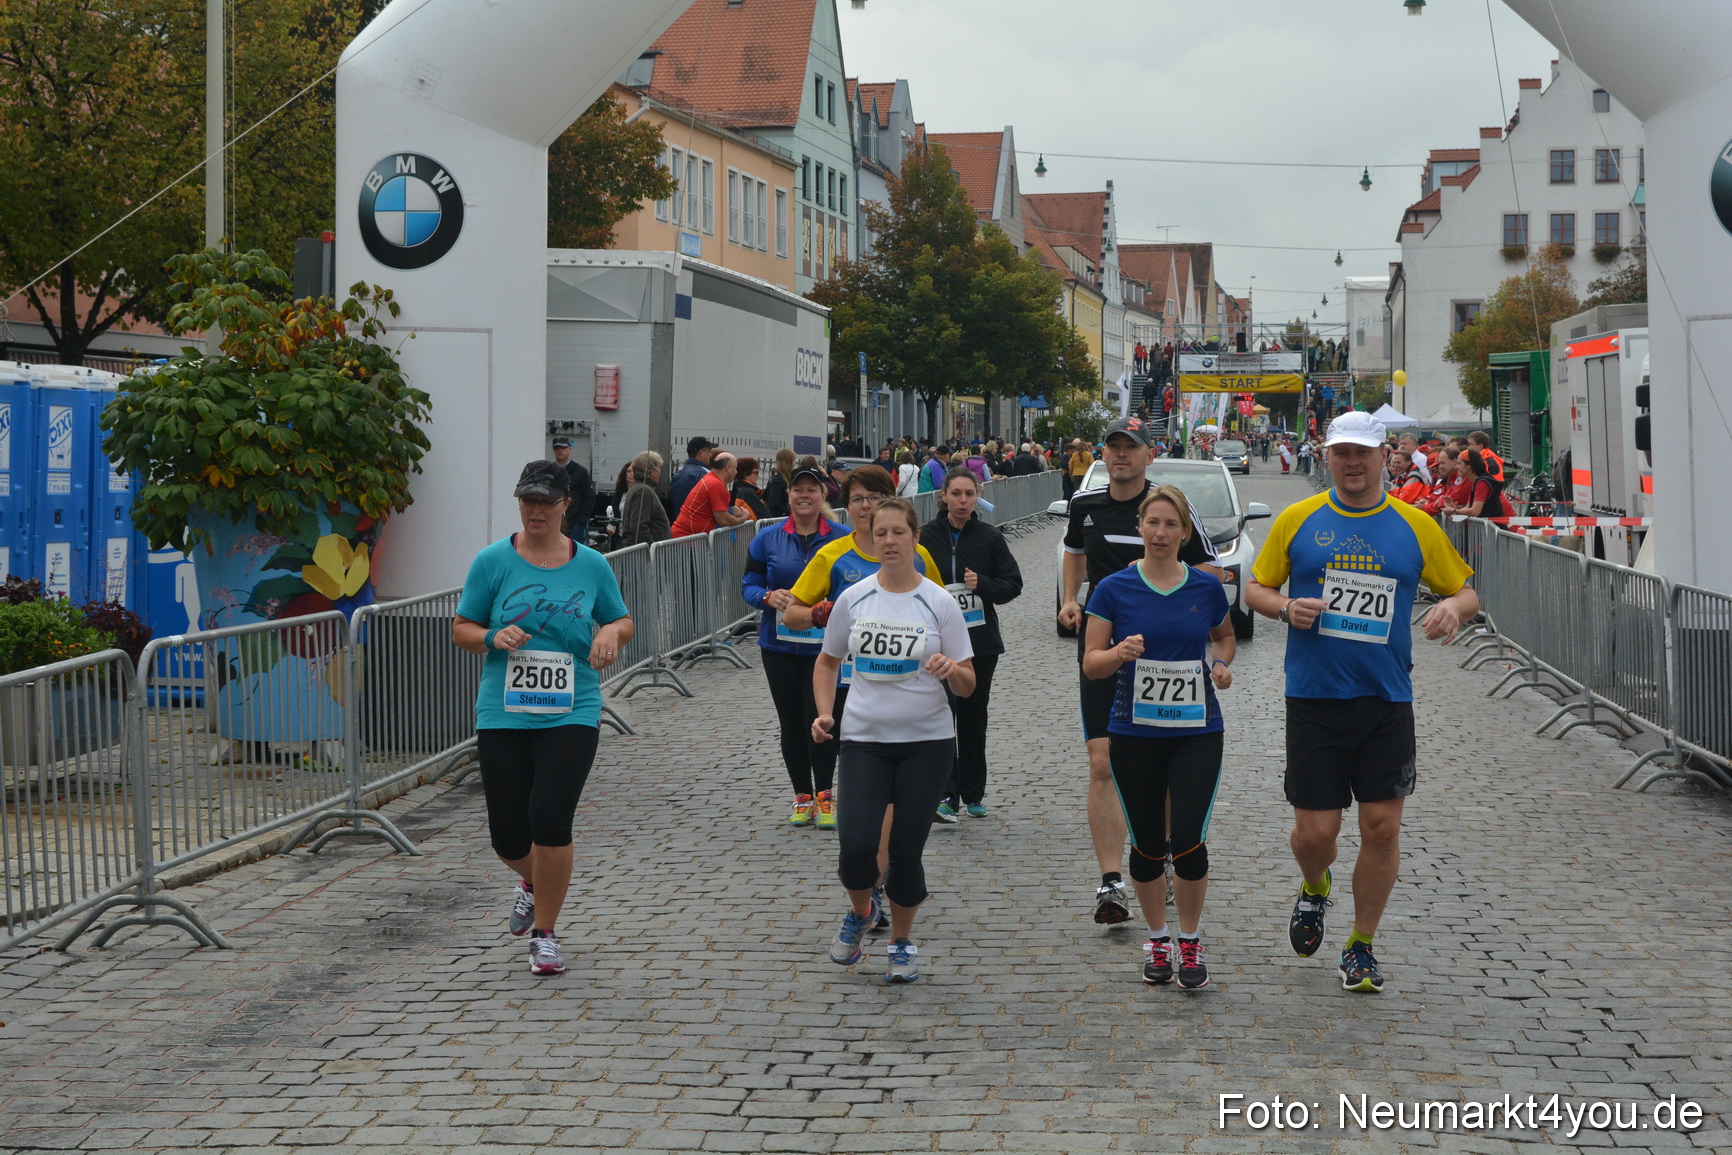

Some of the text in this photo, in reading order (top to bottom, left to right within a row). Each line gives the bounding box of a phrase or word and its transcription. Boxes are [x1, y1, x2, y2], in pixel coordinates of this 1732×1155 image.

[365, 155, 455, 194] BMW
[795, 347, 823, 390] BOCK
[1220, 378, 1262, 388] START
[1326, 575, 1385, 591] PARTL Neumarkt
[1328, 586, 1388, 618] 2720
[856, 622, 914, 633] PARTL Neumarkt
[1341, 618, 1369, 633] David
[860, 630, 919, 658] 2657
[509, 655, 562, 665] PARTL Neumarkt
[869, 661, 904, 672] Annette
[511, 664, 568, 690] 2508
[1136, 665, 1160, 674] PARTL
[1141, 676, 1197, 702] 2721
[519, 694, 556, 704] Stefanie
[1157, 707, 1182, 720] Katja
